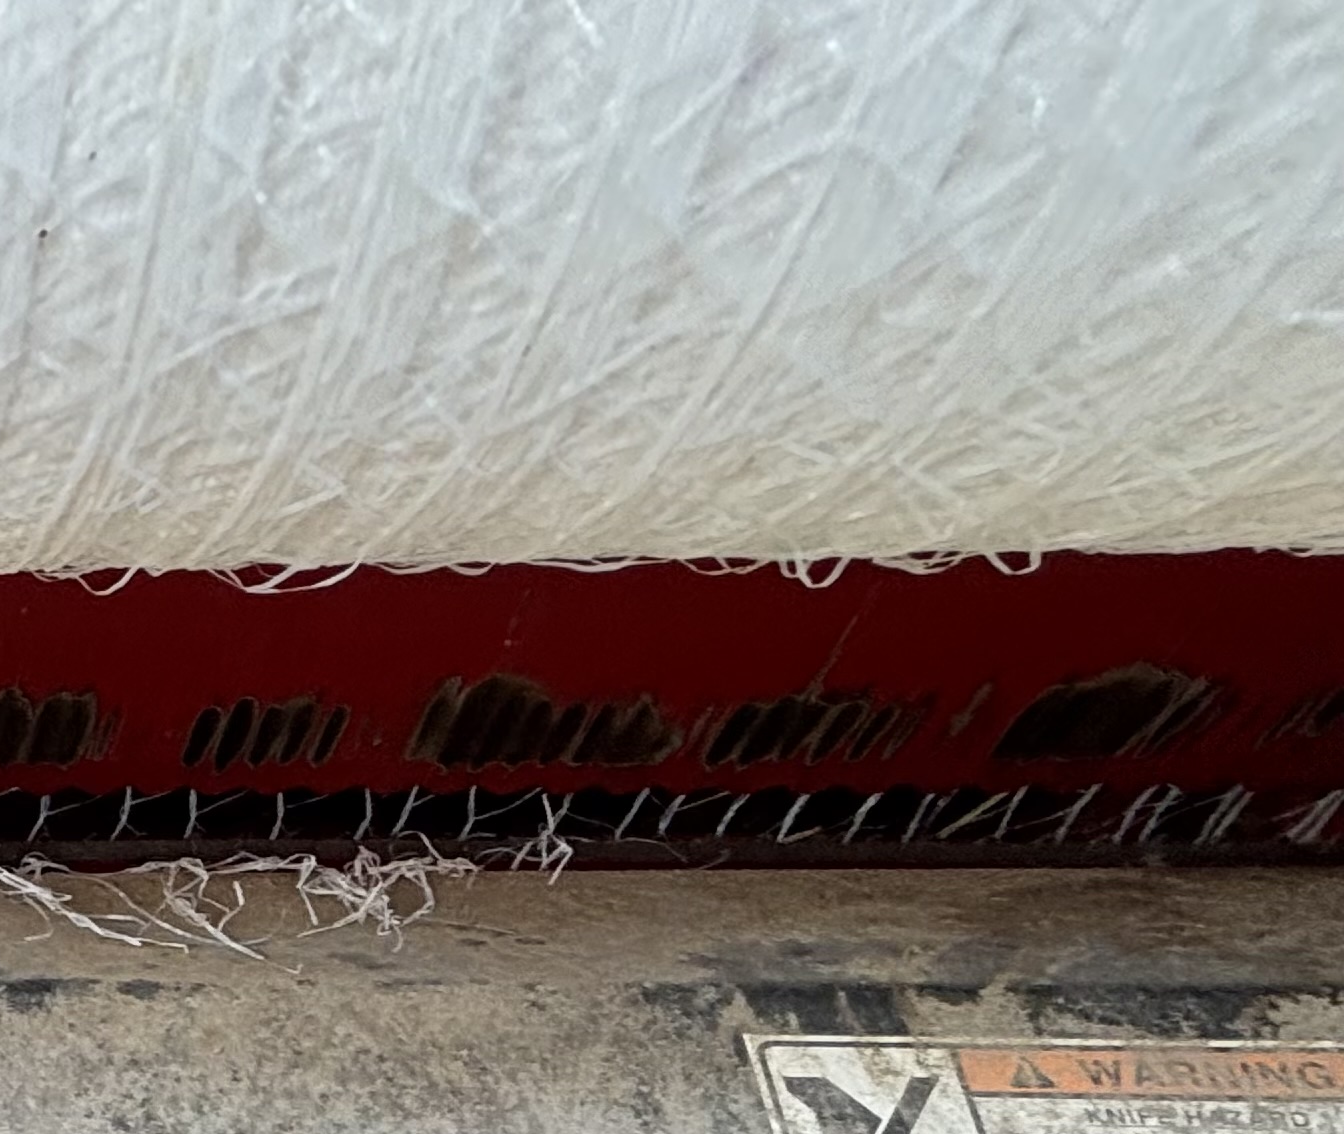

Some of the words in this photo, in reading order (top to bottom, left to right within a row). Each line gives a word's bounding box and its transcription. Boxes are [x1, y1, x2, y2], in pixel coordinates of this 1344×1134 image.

[1076, 1058, 1336, 1090] WARNING
[1084, 1107, 1175, 1125] KNIFE
[1185, 1109, 1311, 1129] HAZARD
